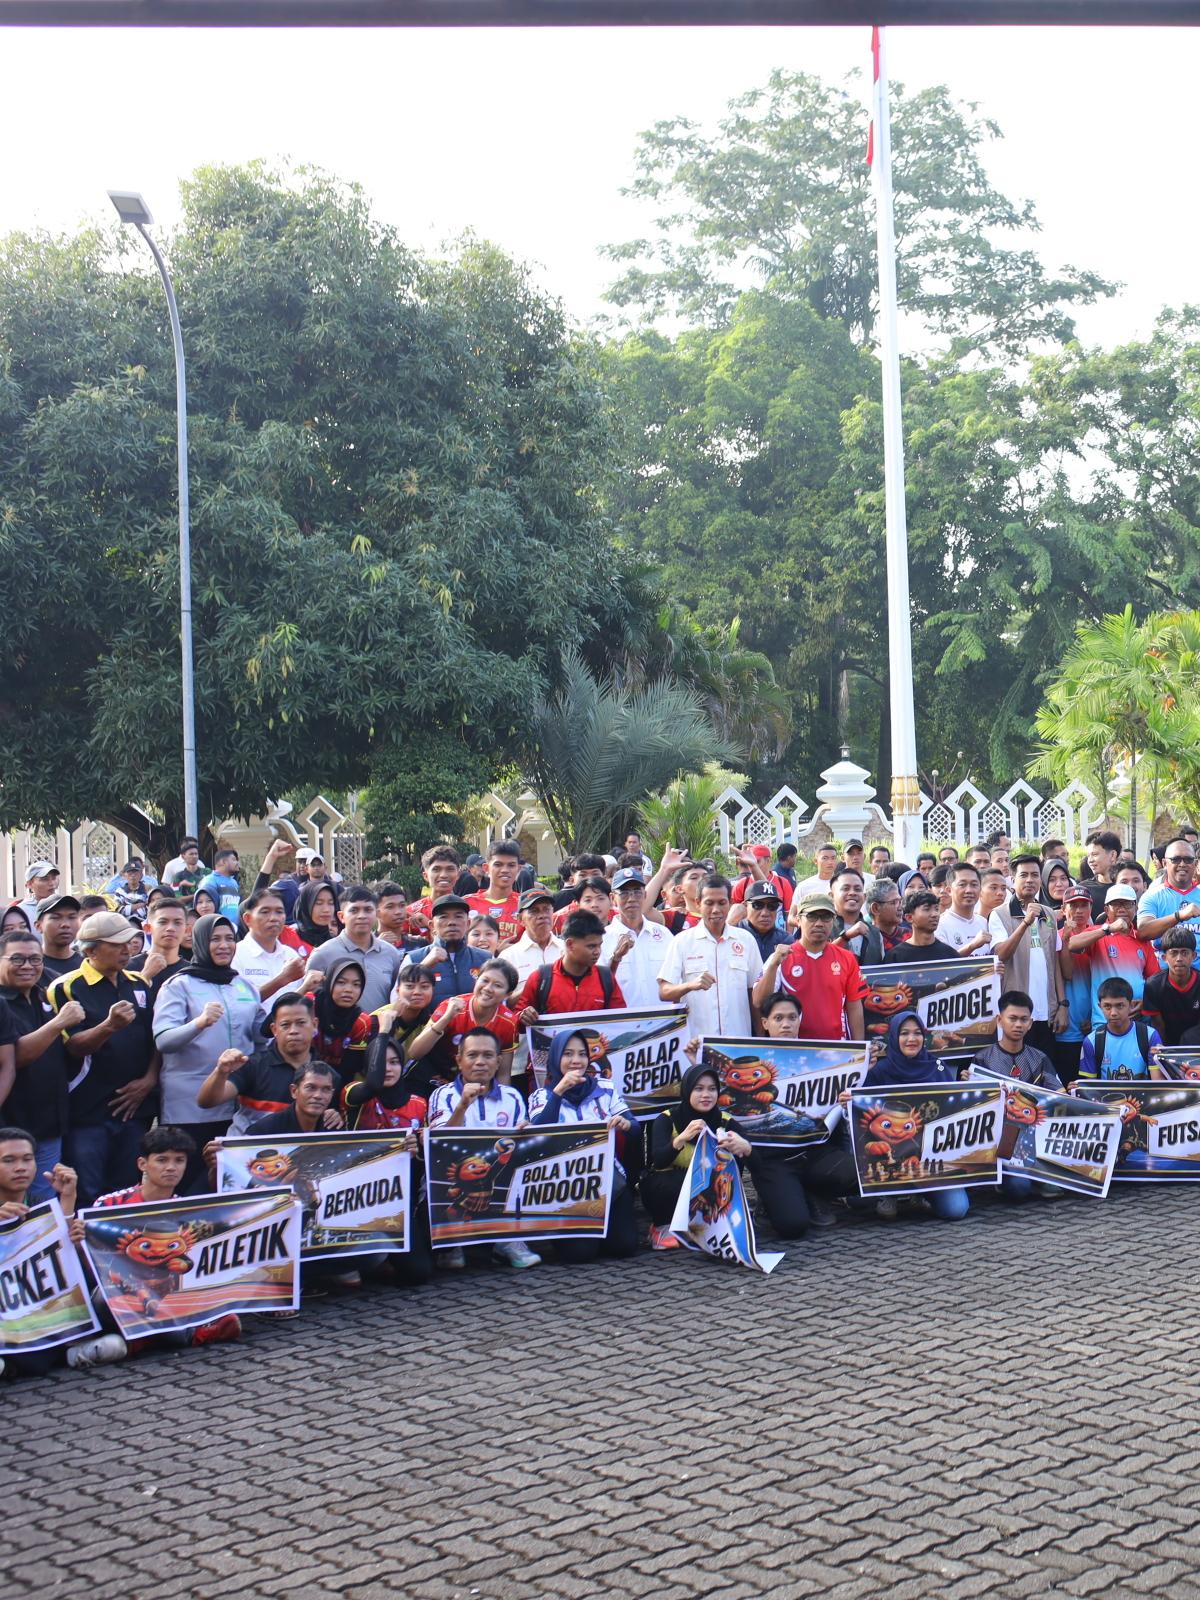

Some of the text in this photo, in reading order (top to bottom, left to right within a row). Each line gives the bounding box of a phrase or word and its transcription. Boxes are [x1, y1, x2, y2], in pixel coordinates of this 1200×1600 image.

[927, 984, 993, 1028] BRIDGE
[624, 1037, 680, 1072] BALAP
[622, 1063, 683, 1095] SEPEDA
[785, 1071, 861, 1107] DAYUNG
[932, 1110, 996, 1154] CATUR
[1049, 1122, 1115, 1143] PANJAT
[521, 1153, 605, 1184] BOLA VOLI
[1044, 1138, 1109, 1164] TEBING
[323, 1175, 403, 1220] BERKUDA
[521, 1175, 600, 1207] INDOOR
[195, 1217, 292, 1279] ATLETIK
[0, 1240, 68, 1315] CKET
